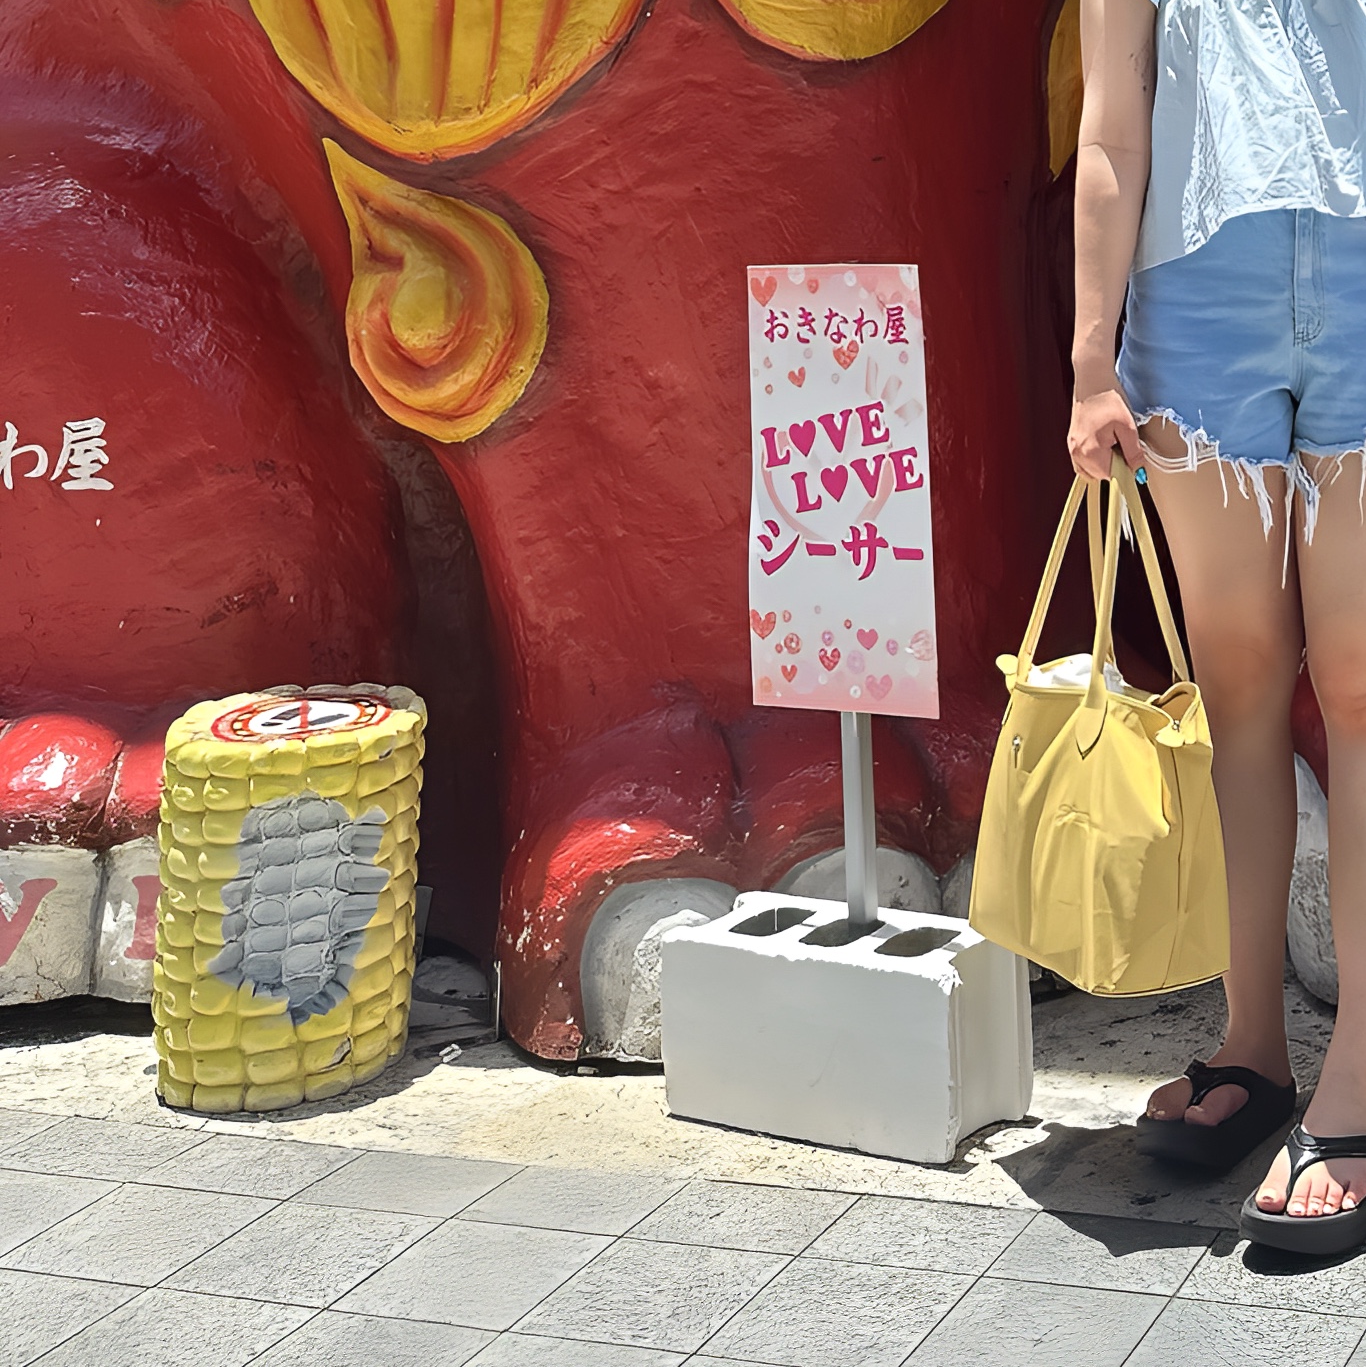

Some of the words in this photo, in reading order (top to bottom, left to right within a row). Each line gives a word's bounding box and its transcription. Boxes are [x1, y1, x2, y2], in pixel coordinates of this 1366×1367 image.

[764, 306, 909, 344] おきなわ屋
[757, 520, 924, 581] シーサー
